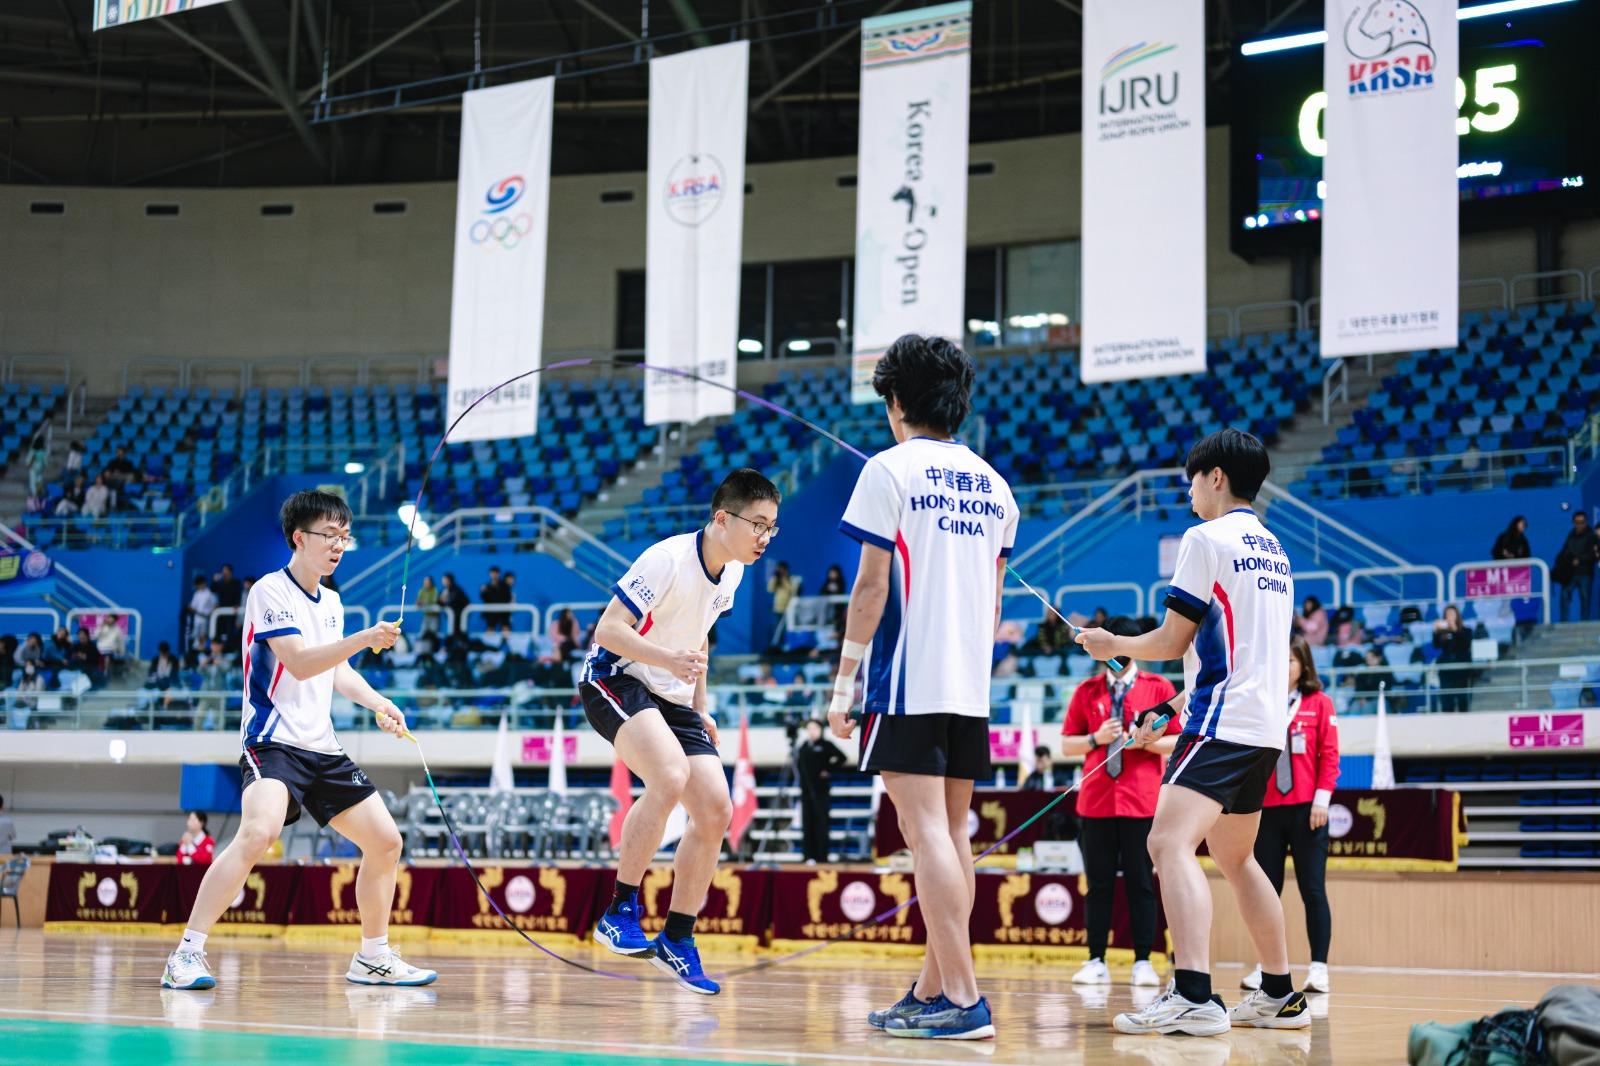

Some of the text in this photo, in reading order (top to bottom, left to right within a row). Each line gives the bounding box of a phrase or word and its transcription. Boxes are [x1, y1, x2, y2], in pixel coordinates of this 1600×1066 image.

[1349, 53, 1434, 94] KRSA
[1099, 71, 1179, 114] IJRU
[895, 99, 931, 305] Korea Open
[926, 465, 992, 494] 中國香港
[911, 494, 1005, 520] HONG KONG
[938, 516, 984, 537] CHINA
[1233, 557, 1273, 573] HONG
[1258, 576, 1288, 596] CHINA
[1539, 712, 1552, 732] N
